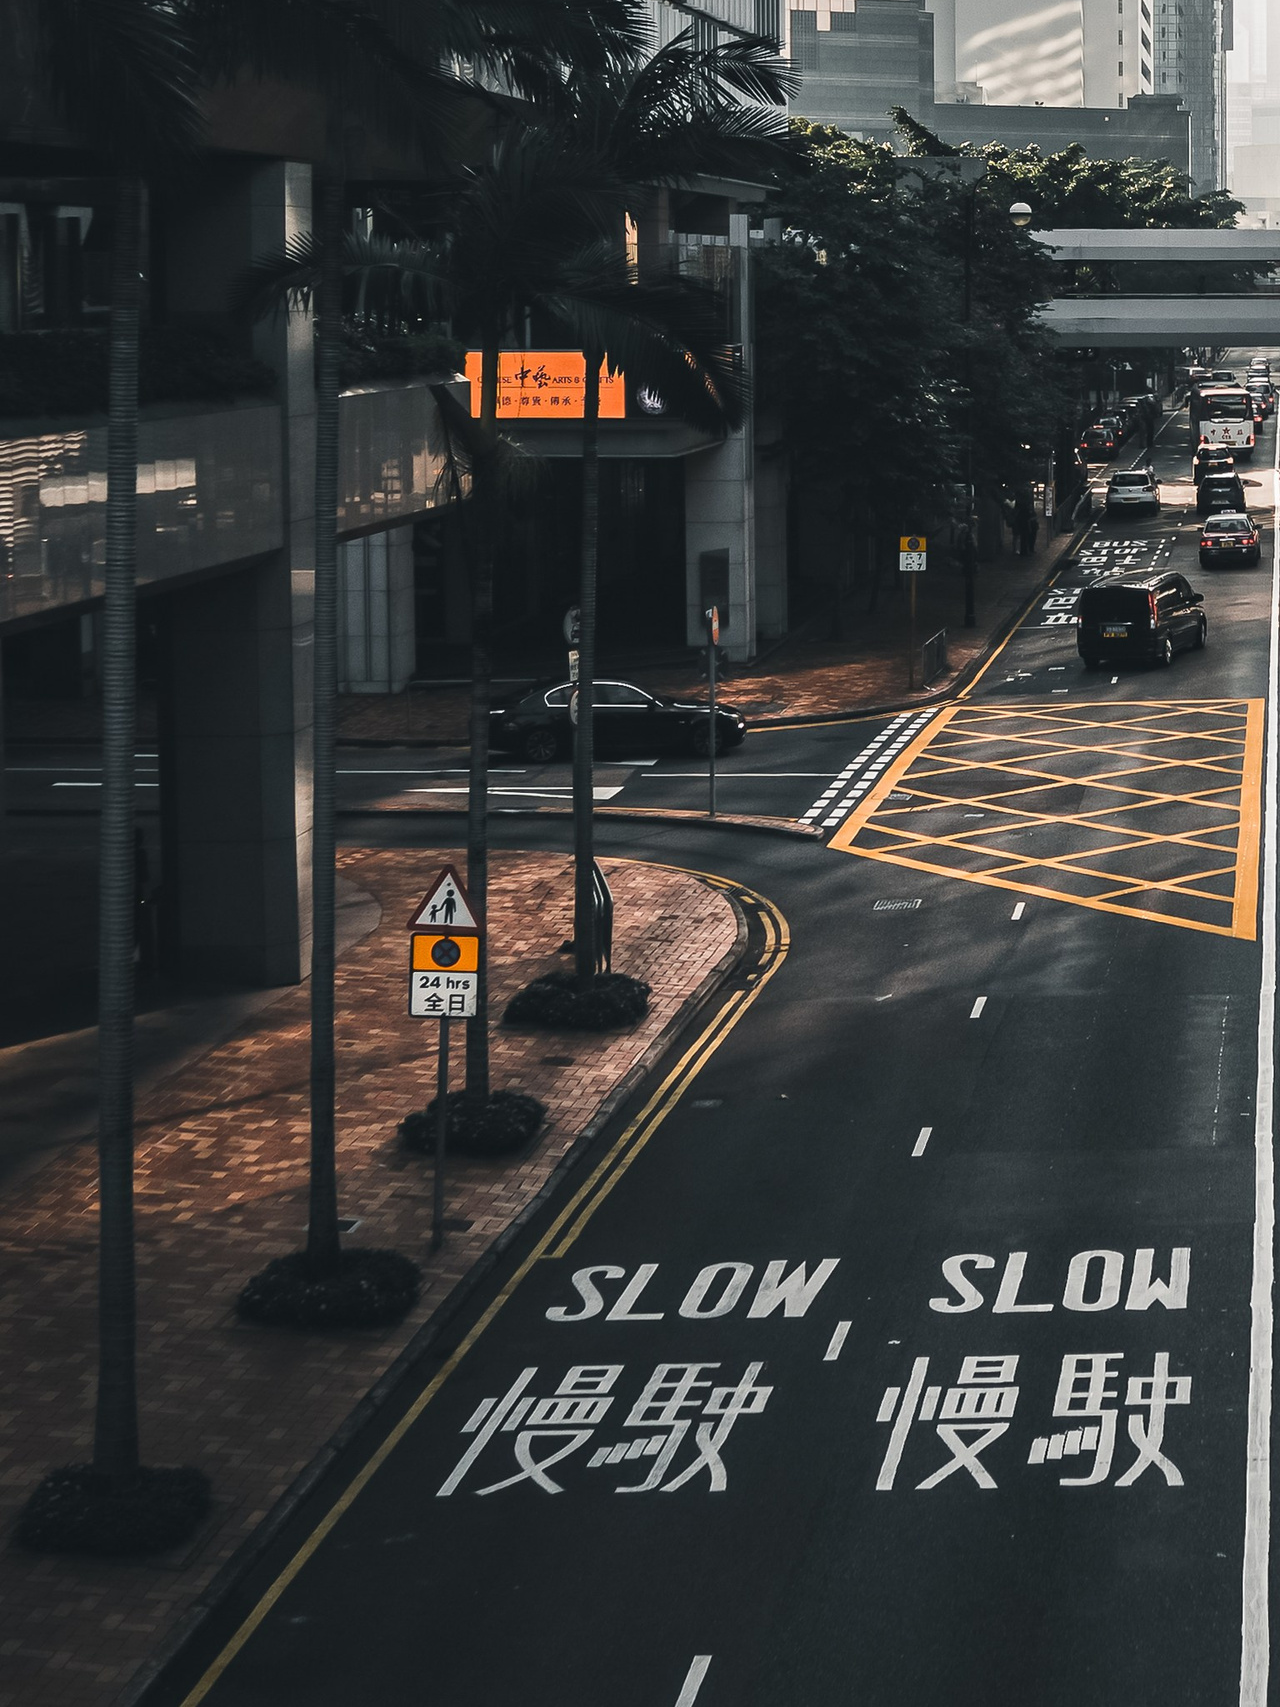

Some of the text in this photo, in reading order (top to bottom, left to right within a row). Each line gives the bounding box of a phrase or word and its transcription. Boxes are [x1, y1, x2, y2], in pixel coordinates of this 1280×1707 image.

[552, 376, 572, 384] ARTS
[1092, 539, 1148, 548] BUS
[1079, 547, 1148, 556] STOP
[1077, 555, 1141, 567] 巴士
[1042, 596, 1079, 610] 巴
[419, 976, 470, 990] 24 hrs
[424, 993, 465, 1013] 全日
[928, 1247, 1192, 1315] SLOW
[545, 1258, 840, 1322] SLOW
[875, 1352, 1193, 1491] 慢駛
[435, 1361, 775, 1497] 慢駛
